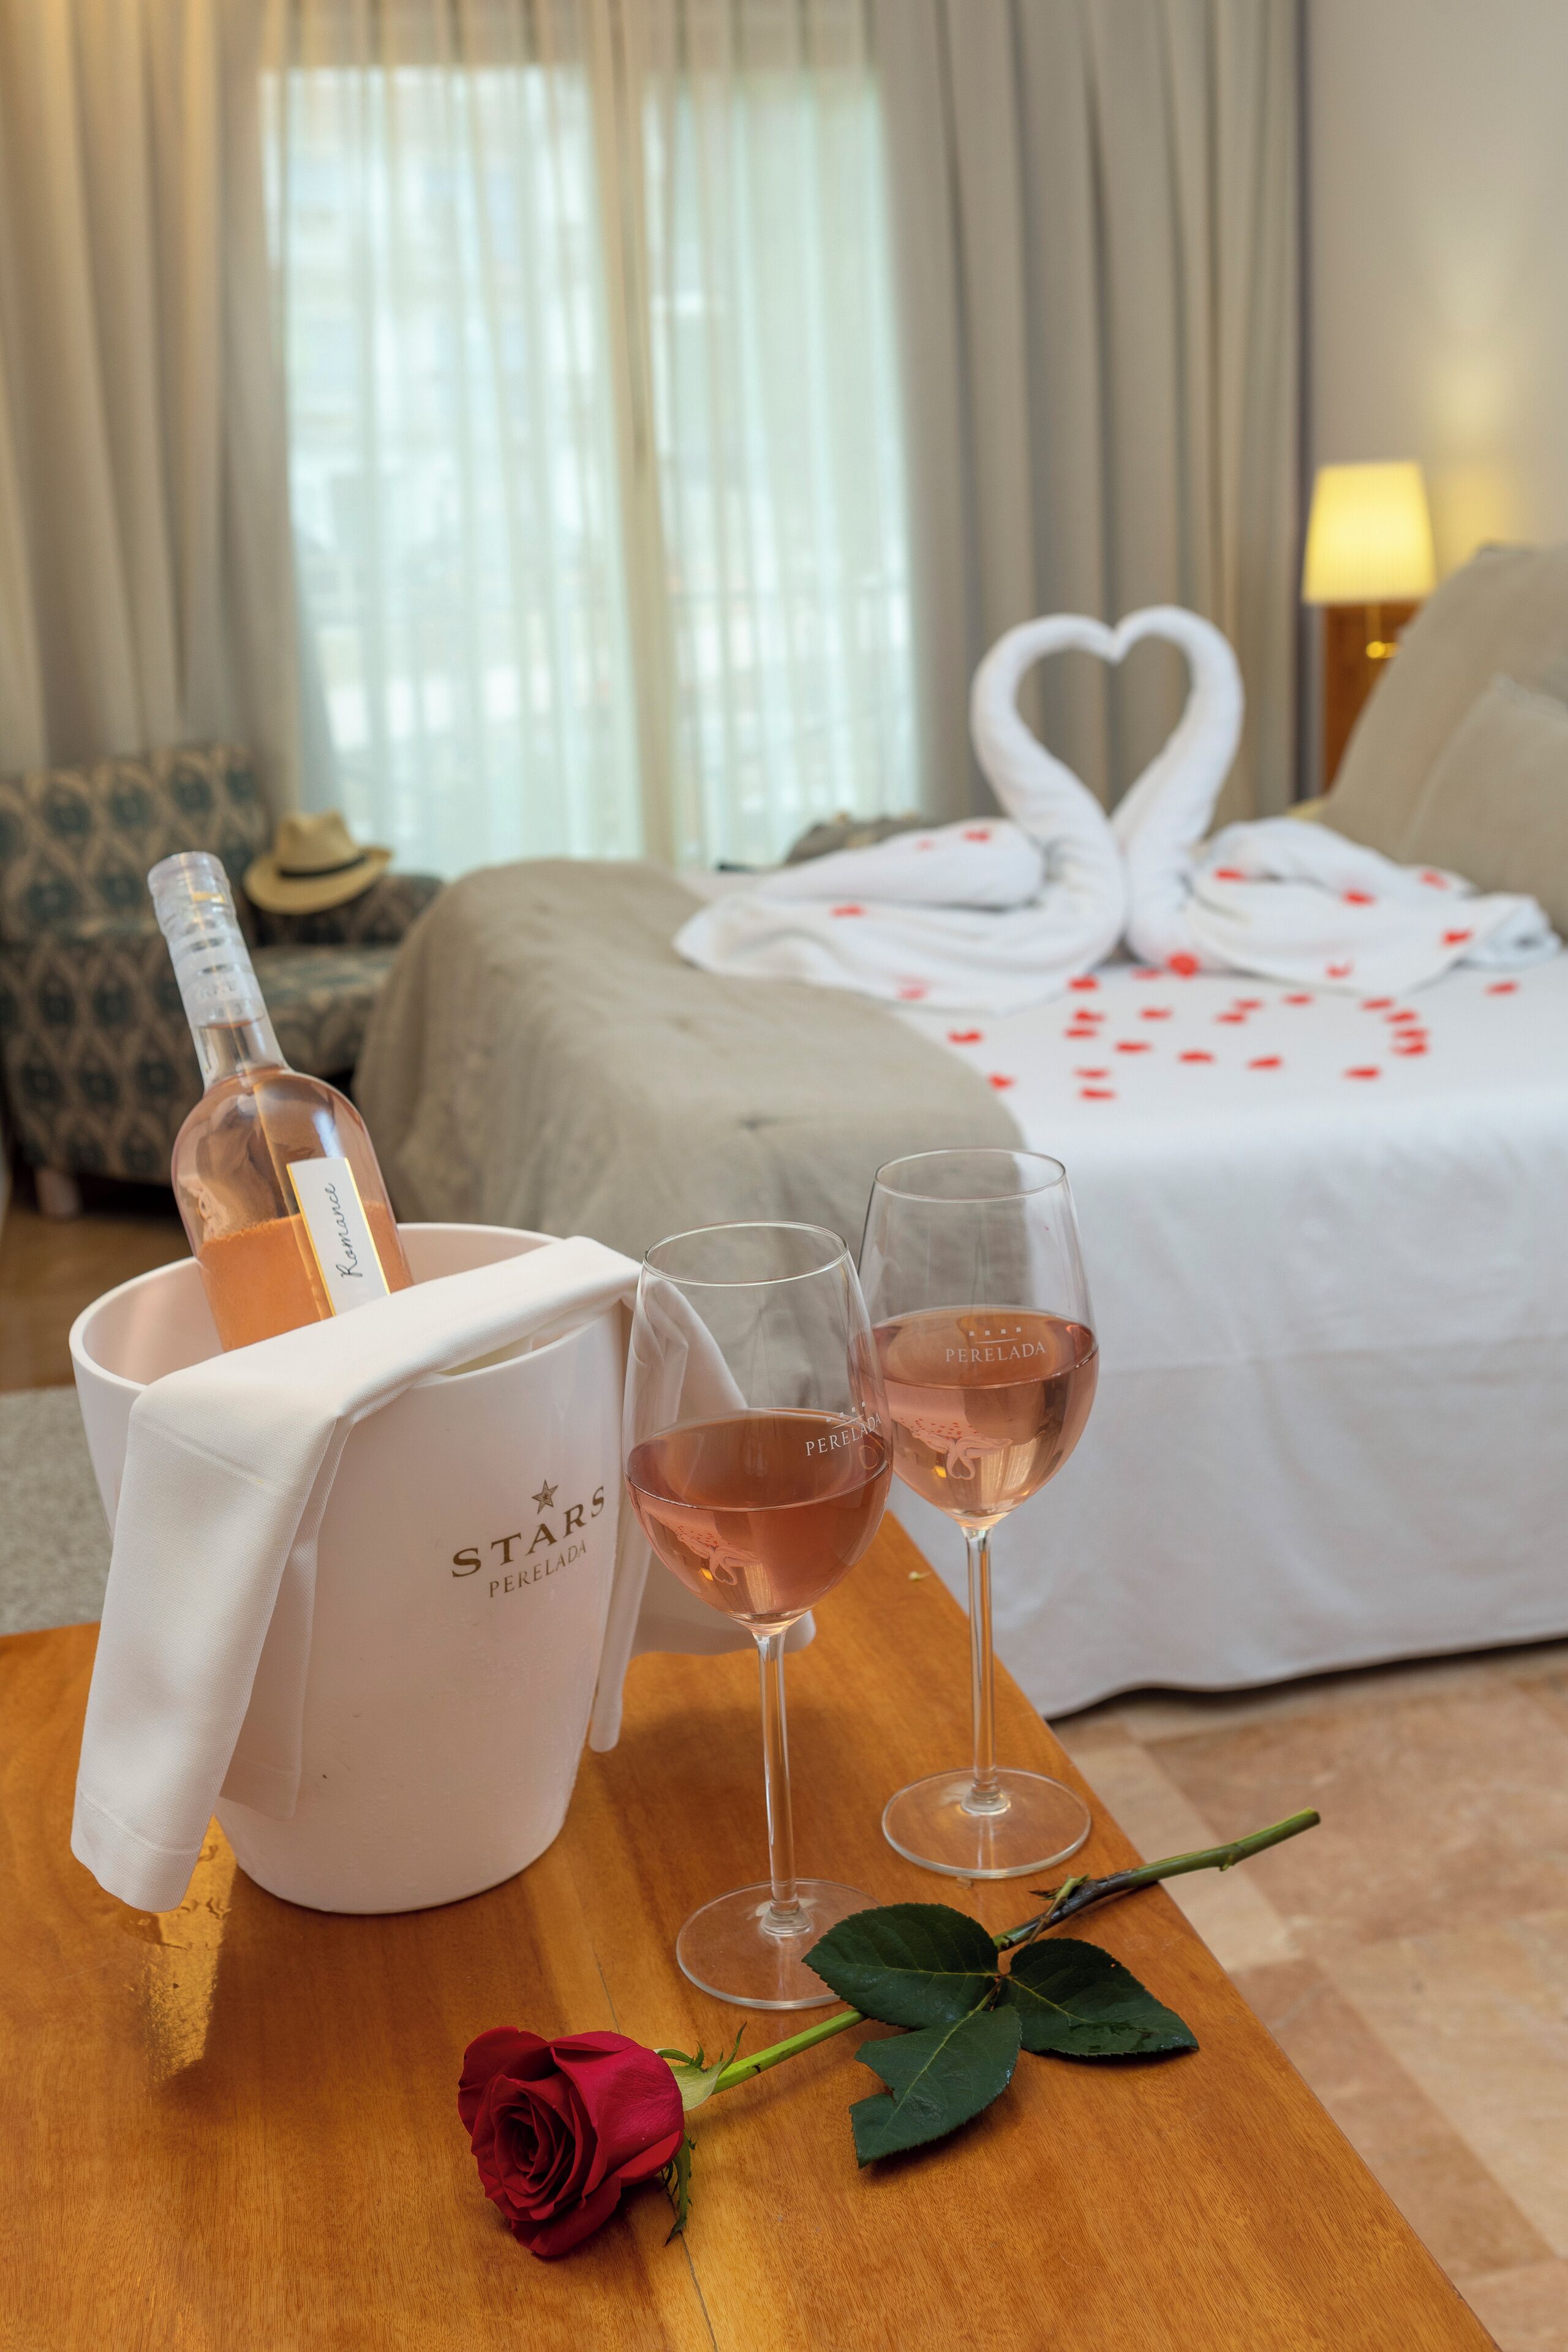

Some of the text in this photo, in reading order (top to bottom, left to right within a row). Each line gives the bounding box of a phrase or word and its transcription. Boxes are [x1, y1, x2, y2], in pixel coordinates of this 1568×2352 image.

[325, 1182, 363, 1278] Romance
[945, 1341, 1046, 1363] PERELADA
[805, 1412, 882, 1457] PERELADA
[451, 1485, 605, 1577] STARS
[489, 1539, 587, 1597] PERELADA
